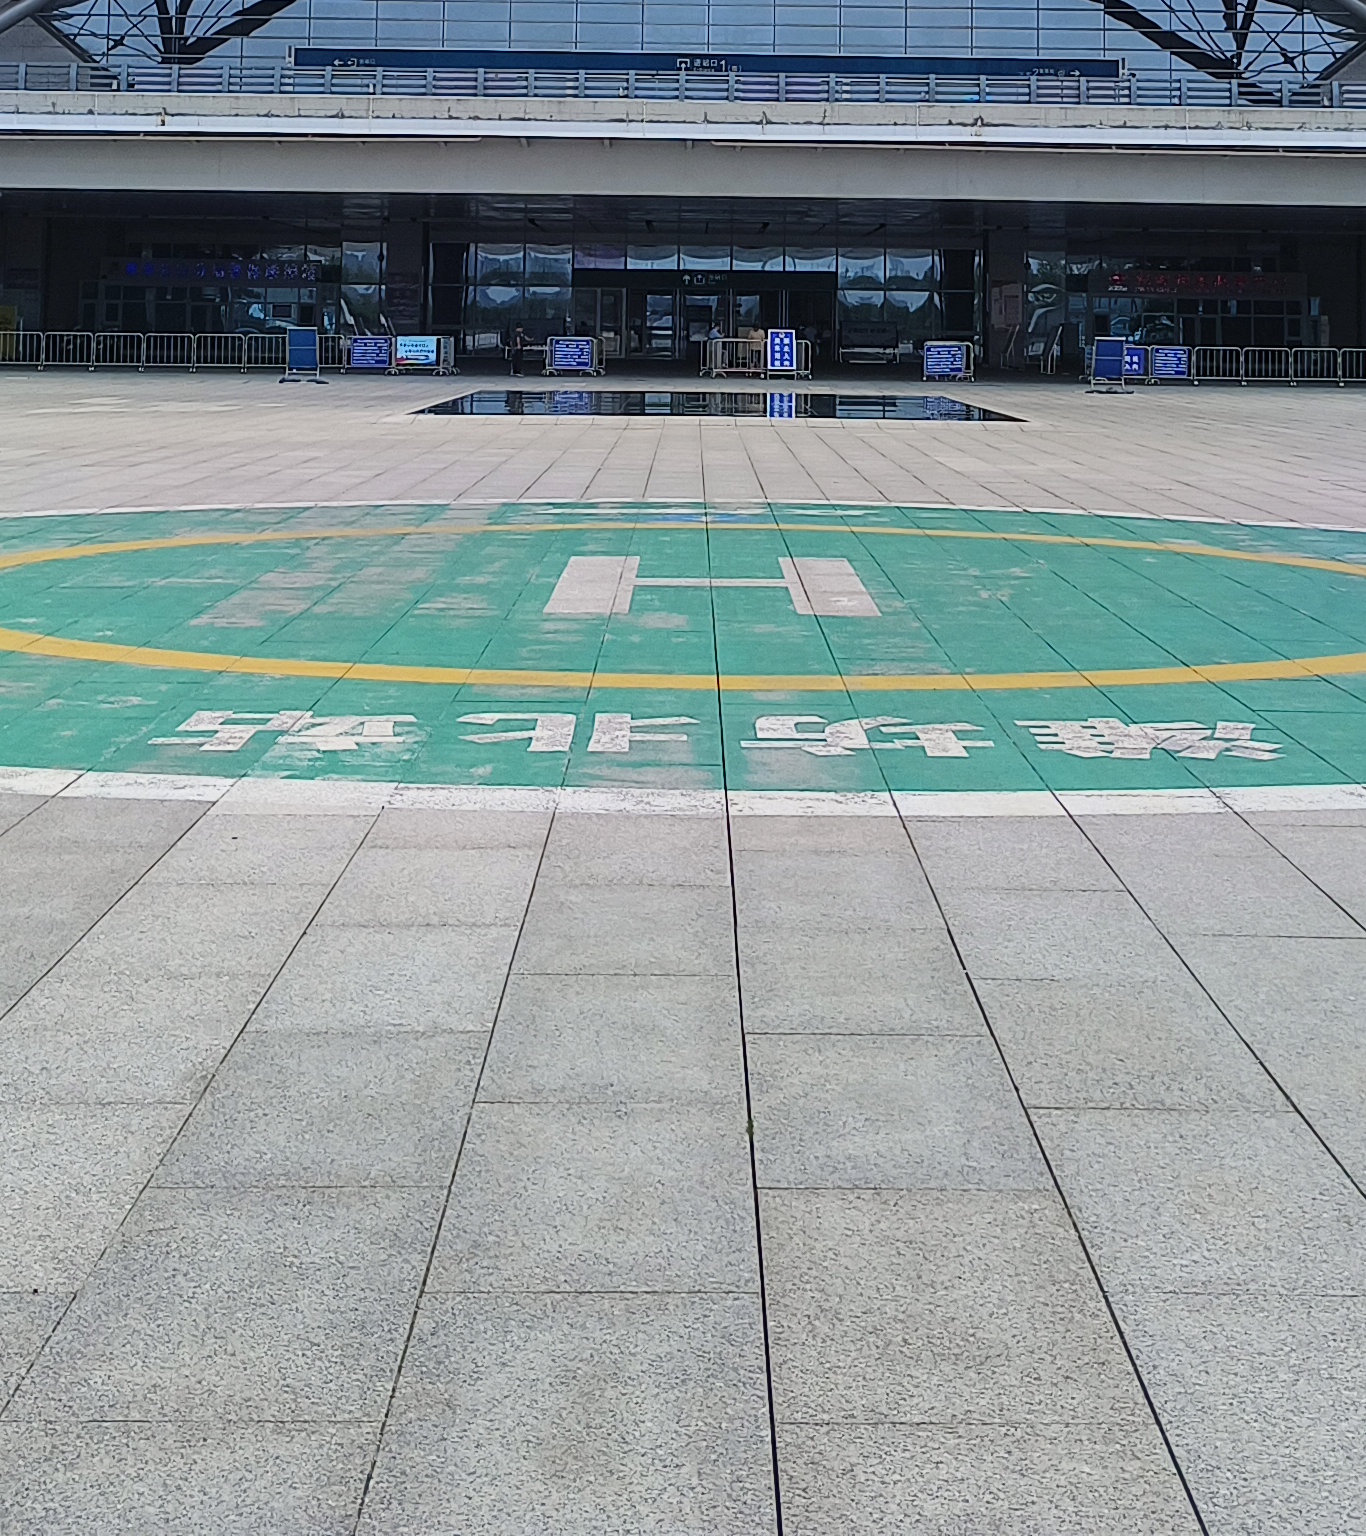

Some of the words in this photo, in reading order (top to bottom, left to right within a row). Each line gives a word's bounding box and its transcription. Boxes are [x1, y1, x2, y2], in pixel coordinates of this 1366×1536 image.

[543, 555, 883, 617] H
[146, 712, 1289, 763] 潍坊北站
